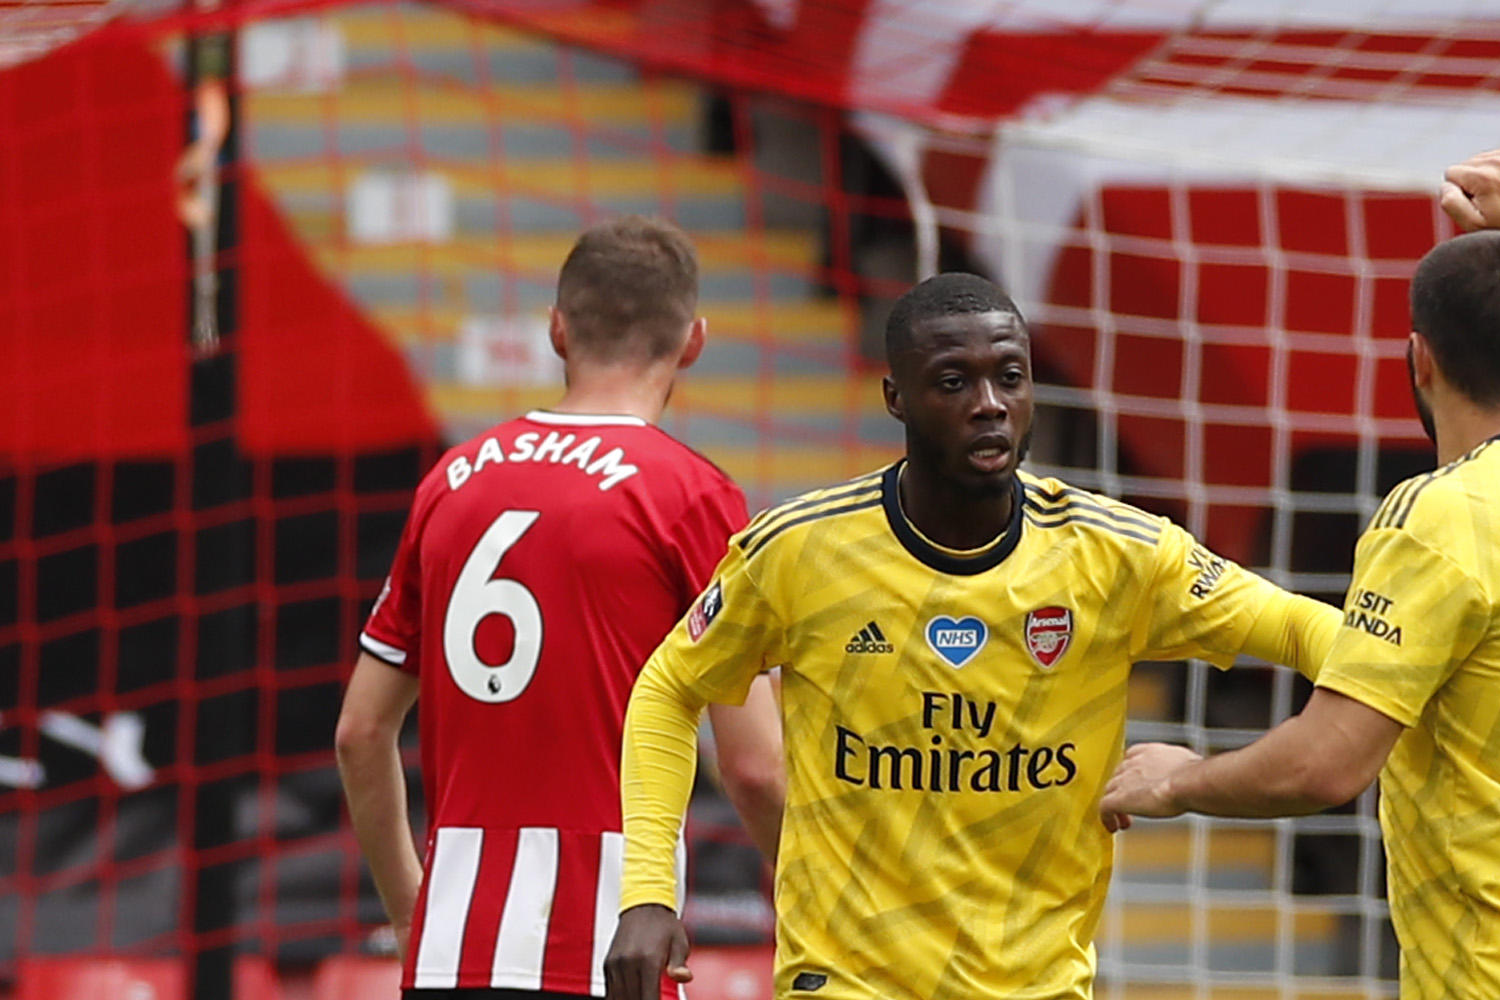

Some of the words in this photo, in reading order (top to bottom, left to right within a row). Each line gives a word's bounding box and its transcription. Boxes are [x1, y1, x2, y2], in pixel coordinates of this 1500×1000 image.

[446, 431, 639, 491] BASHAM
[443, 510, 544, 704] 6
[1028, 613, 1071, 632] Arsenal
[845, 640, 894, 654] adidas
[938, 629, 976, 647] NHS
[922, 692, 997, 737] Fly
[835, 725, 1077, 793] Emirates
